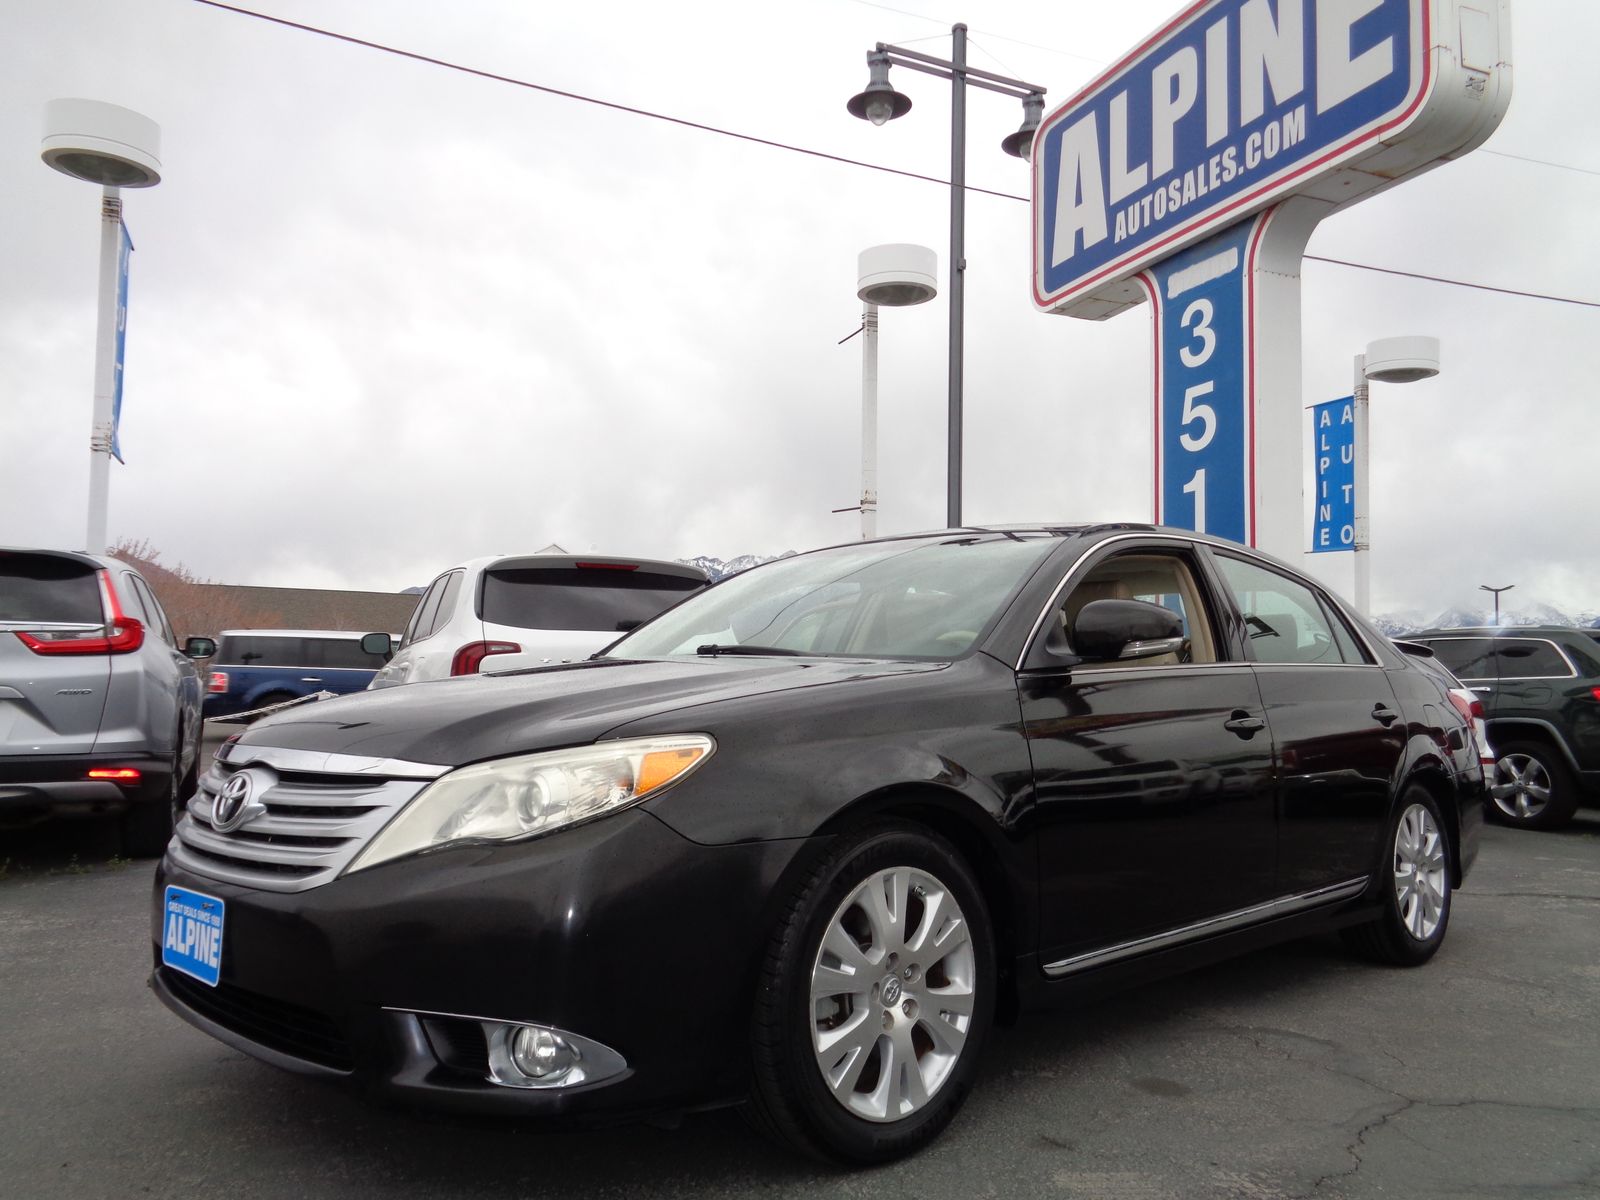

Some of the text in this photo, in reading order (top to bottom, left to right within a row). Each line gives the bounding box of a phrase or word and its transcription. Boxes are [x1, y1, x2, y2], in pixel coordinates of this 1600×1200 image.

[1052, 0, 1393, 268] ALPINE
[1114, 104, 1306, 244] AUTOSALES.COM
[1319, 409, 1331, 546] ALPINE
[1340, 404, 1354, 545] AUTO
[55, 688, 93, 696] AWD
[166, 914, 219, 968] ALPINE
